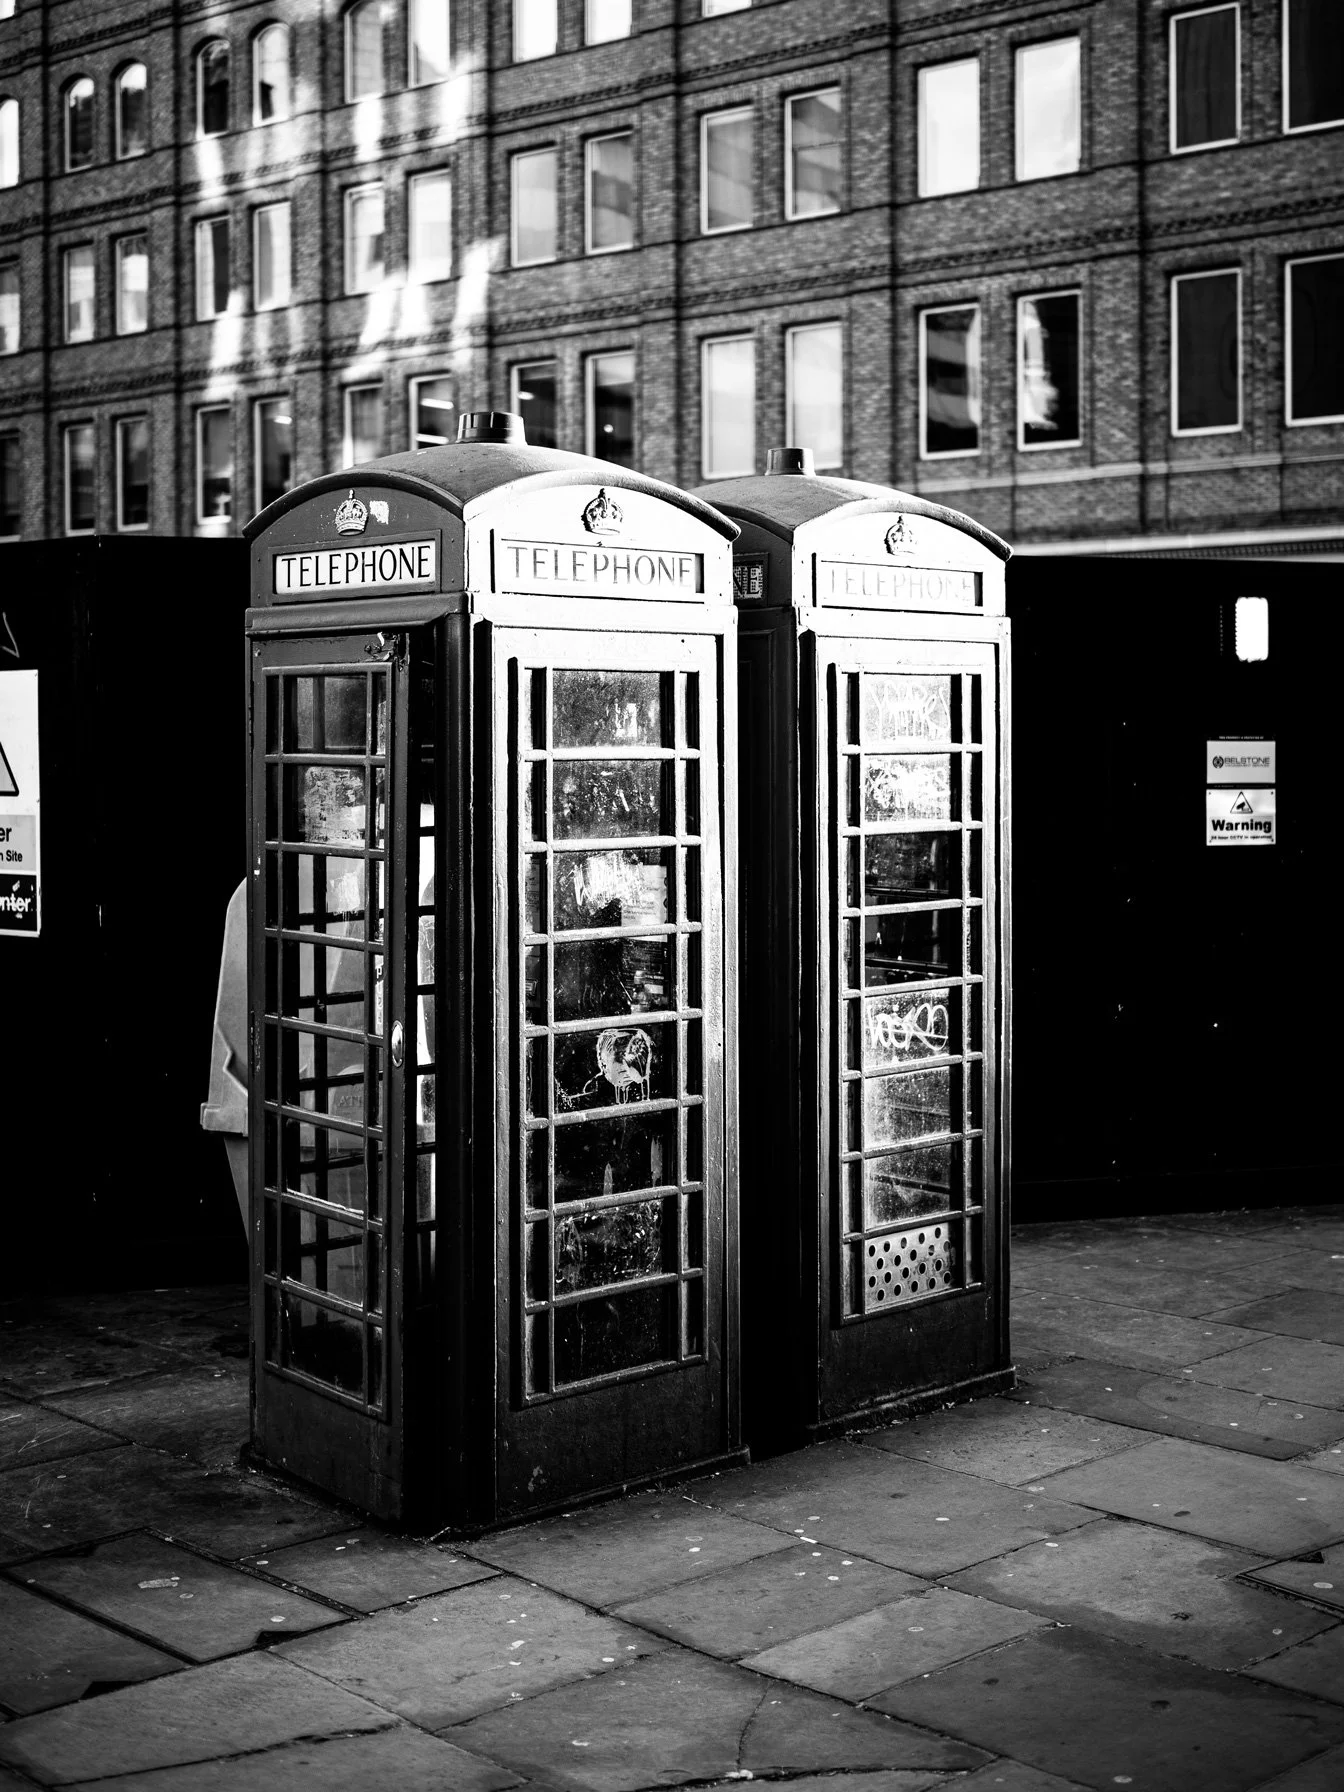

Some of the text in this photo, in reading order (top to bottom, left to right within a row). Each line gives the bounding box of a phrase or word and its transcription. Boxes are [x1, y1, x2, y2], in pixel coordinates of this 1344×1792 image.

[281, 545, 431, 588] TELEPHONE
[507, 546, 693, 588] TELEPHONE
[830, 567, 973, 601] TELEPHONE
[1211, 818, 1272, 833] Warning
[6, 849, 23, 862] Site
